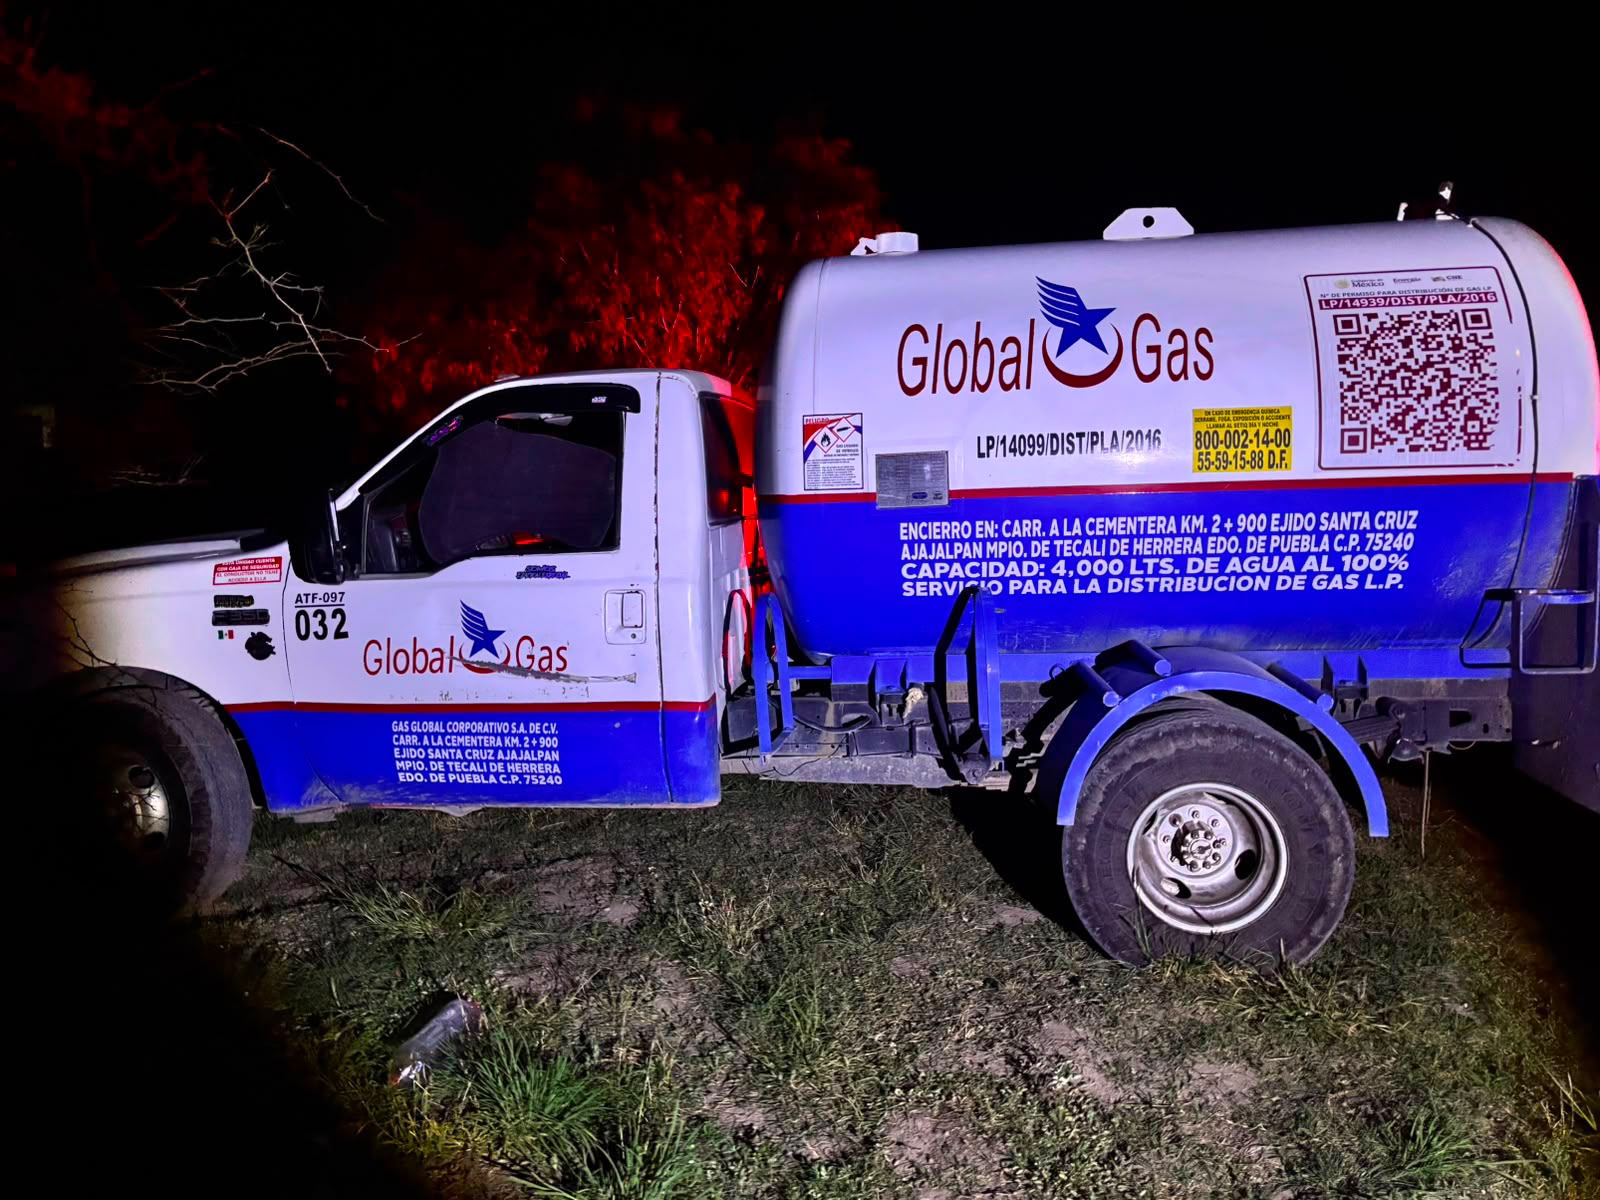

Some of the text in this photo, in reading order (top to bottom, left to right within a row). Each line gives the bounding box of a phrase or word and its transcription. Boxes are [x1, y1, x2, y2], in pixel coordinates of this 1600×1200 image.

[1321, 292, 1496, 309] LP/14939/DIST/PLA/2016
[897, 313, 1214, 397] Global Gas
[977, 428, 1162, 459] LP/14099/DIST/PLA/2016
[1195, 428, 1291, 450] 800-002-14-00
[1197, 449, 1288, 470] 55-59-15-88 D.F.
[900, 510, 1419, 540] ENCIERRO EN: CARR. A LA CEMENTERA KM. 2 + 900 EJIDO SANTA CRUZ
[901, 532, 1415, 561] AJAJALPAN MPIO. DE TECALI DE HERRERA EDO. DE PUEBLA C.P. 75240
[901, 553, 1409, 579] CAPACIDAD: 4,000 LTS. DE AGUA AL 100%
[1008, 578, 1067, 595] PARA
[1073, 578, 1101, 594] LA
[1107, 575, 1270, 593] DISTRIBUCION
[1275, 574, 1307, 591] DE
[1312, 573, 1359, 591] GAS
[1364, 572, 1404, 590] L.P.
[294, 591, 346, 605] ATF-097
[295, 608, 349, 641] 032
[363, 635, 568, 676] Global Gas
[392, 721, 559, 735] GAS GLOBAL CORPORATIVO S.A. DE C.V.
[392, 735, 558, 748] CARR. A LA CEMENTERA KM. 2 + 900
[394, 748, 560, 762] EJIDO SANTA CRUZ AJAJALPAN
[396, 760, 561, 774] MPIO. DE TECALI DE HERRERA
[398, 772, 563, 785] EDO. DE PUEBLA C.P. 75240
